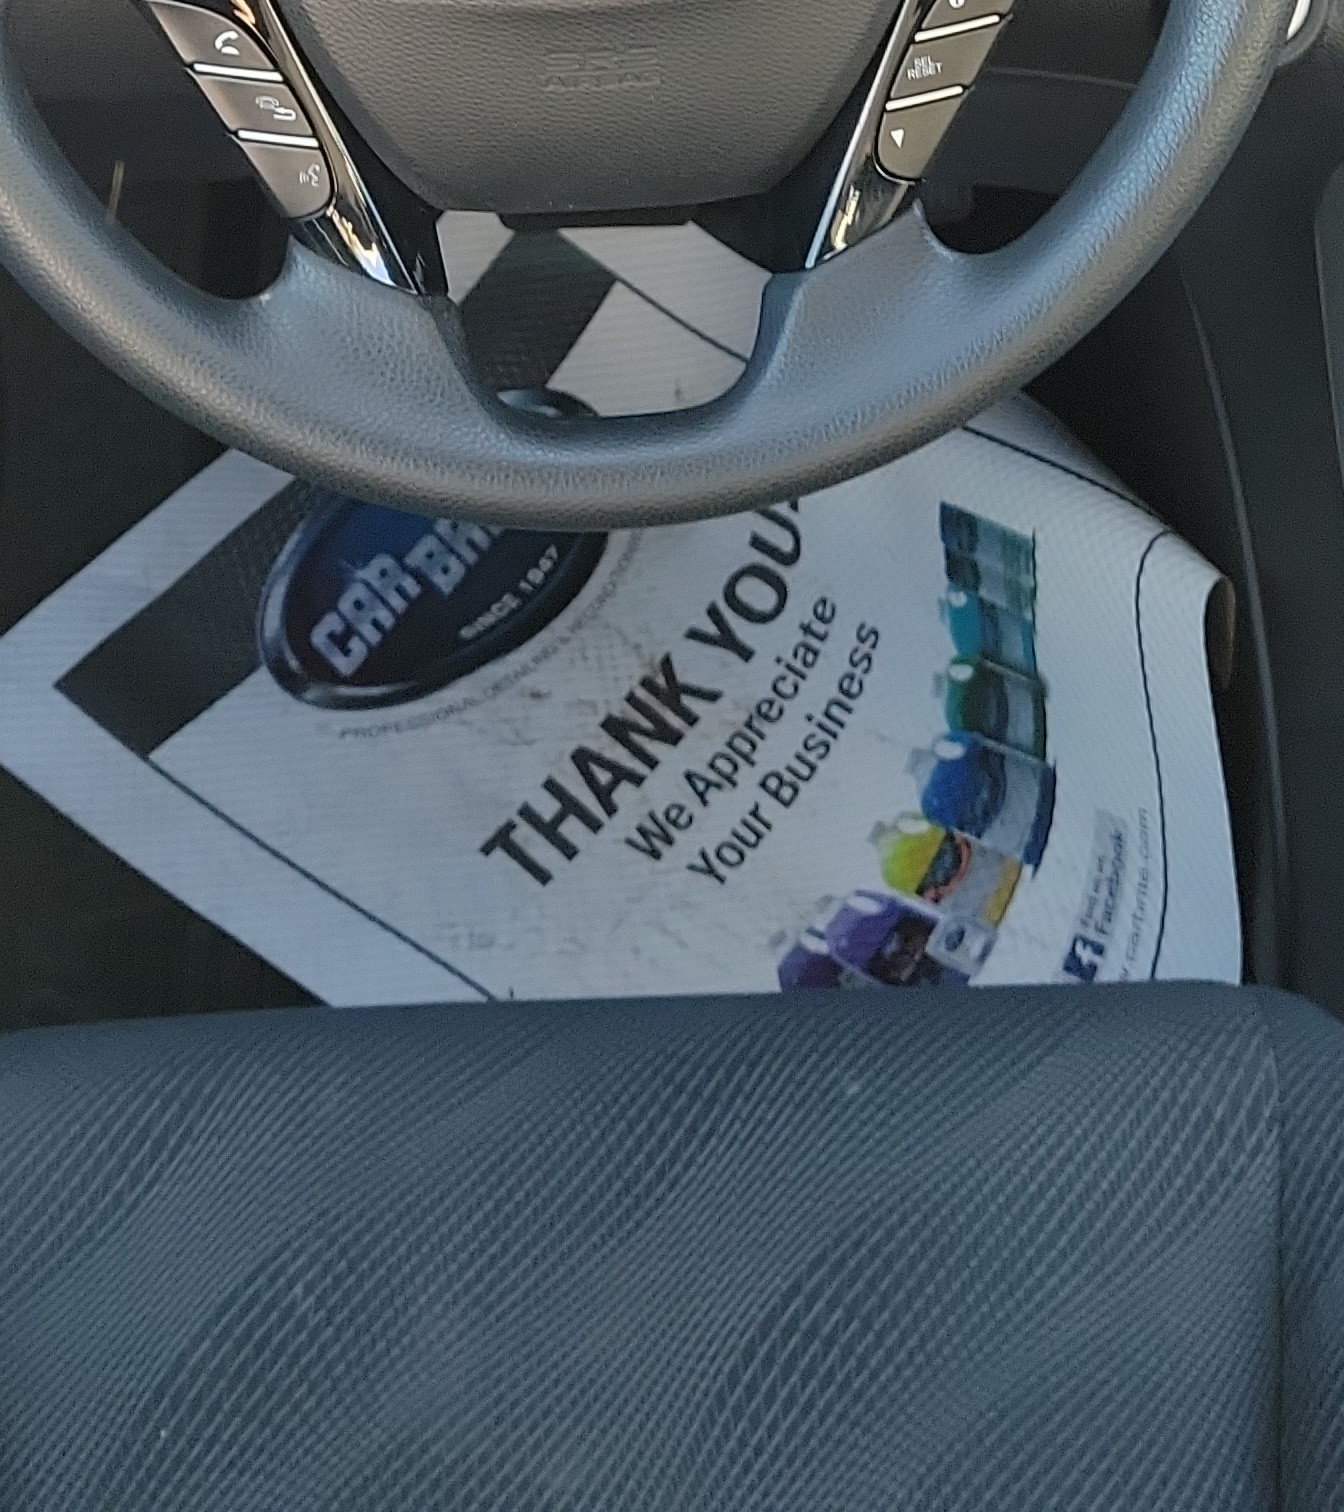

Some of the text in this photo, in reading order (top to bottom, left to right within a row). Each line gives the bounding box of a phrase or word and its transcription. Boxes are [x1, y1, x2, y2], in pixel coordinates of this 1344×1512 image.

[309, 552, 423, 678] CAR
[623, 594, 837, 863] We Appreciate
[478, 652, 724, 888] THANK
[686, 621, 881, 886] Your Business
